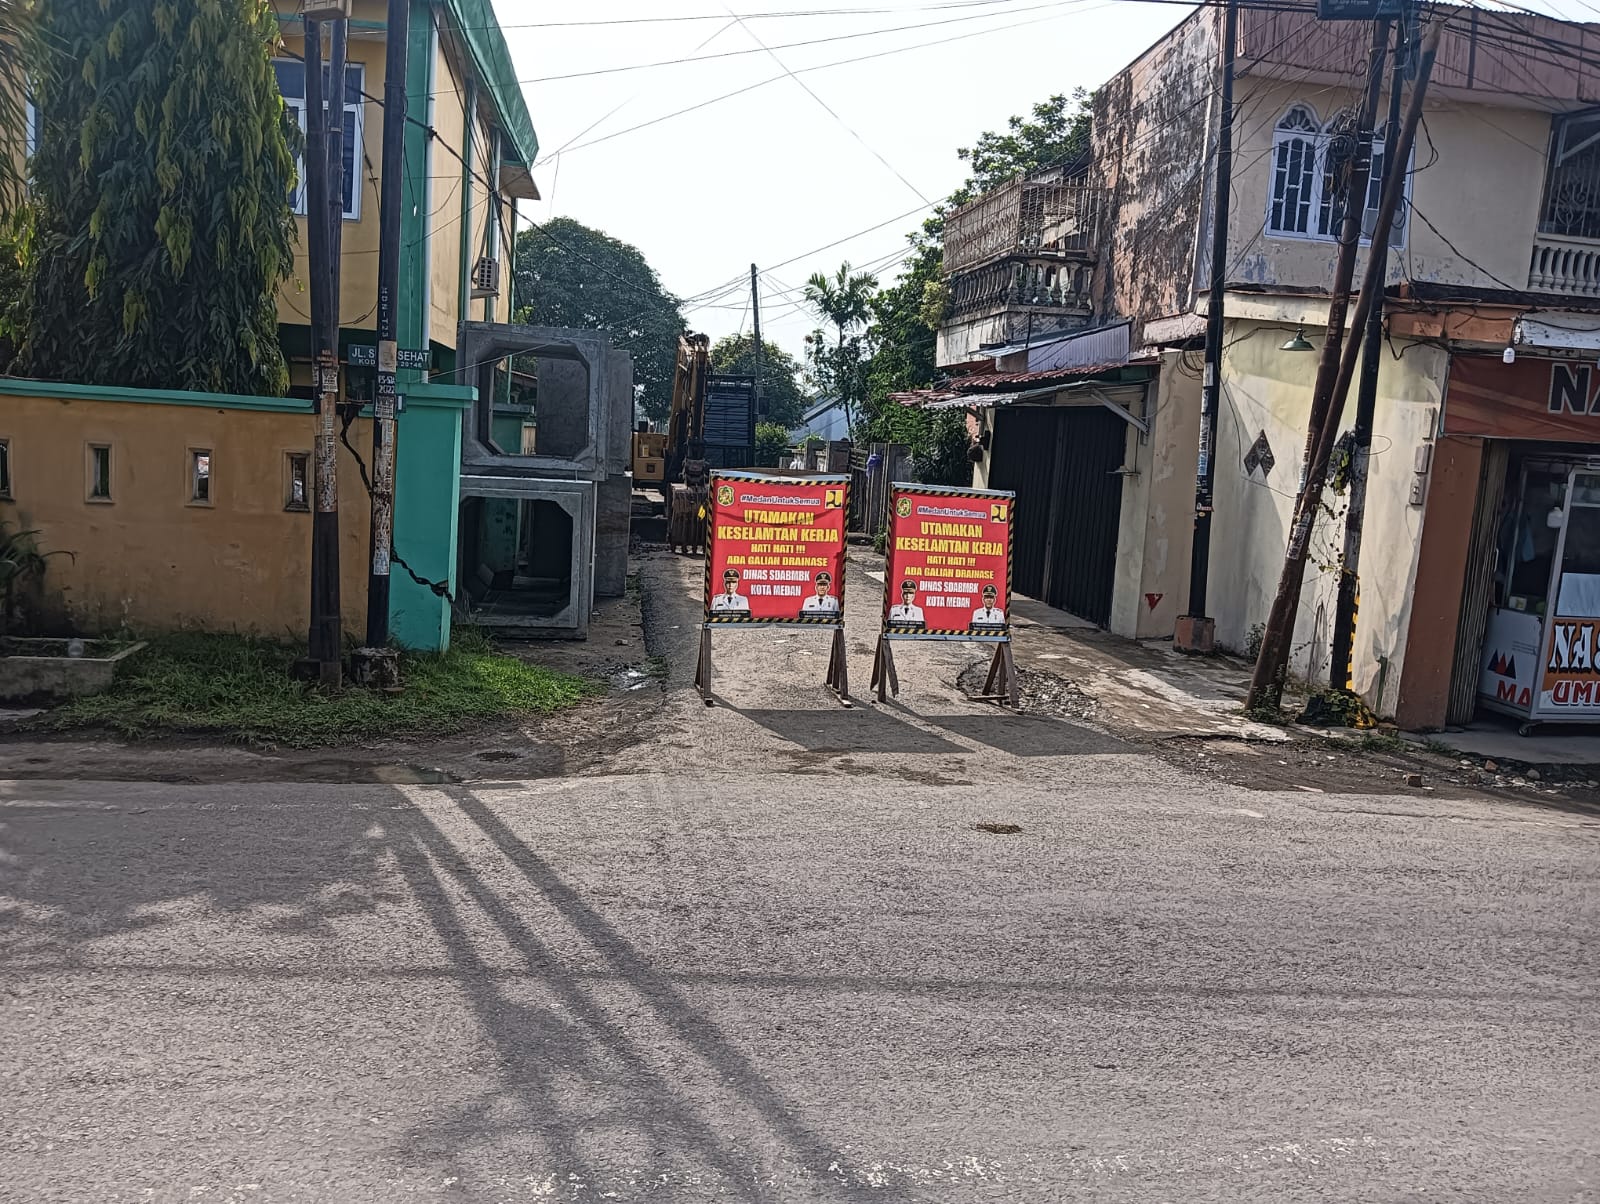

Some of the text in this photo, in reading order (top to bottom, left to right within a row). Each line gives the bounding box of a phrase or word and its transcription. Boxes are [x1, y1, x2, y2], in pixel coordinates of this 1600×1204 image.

[352, 348, 366, 358] JL.
[397, 351, 429, 362] SEHAT
[741, 495, 820, 505] #MedanUntukSemua
[744, 510, 814, 525] UTAMAKAN
[717, 526, 839, 542] KESELAMTAN KERJA
[920, 521, 983, 538] UTAMAKAN
[751, 544, 806, 554] HATI HATI !!!
[896, 537, 1003, 556] KESELAMTAN KERJA
[727, 556, 828, 567] ADA GALIAN DRAINASE
[927, 555, 945, 565] HATI
[947, 556, 966, 566] HATI
[743, 569, 810, 581] DINAS SDABMBK
[905, 566, 994, 579] ADA GALIAN DRAINASE
[750, 585, 801, 596] KOTA MEDAN
[919, 581, 979, 593] DINAS SDABMBK
[926, 596, 970, 608] KOTA MEDAN
